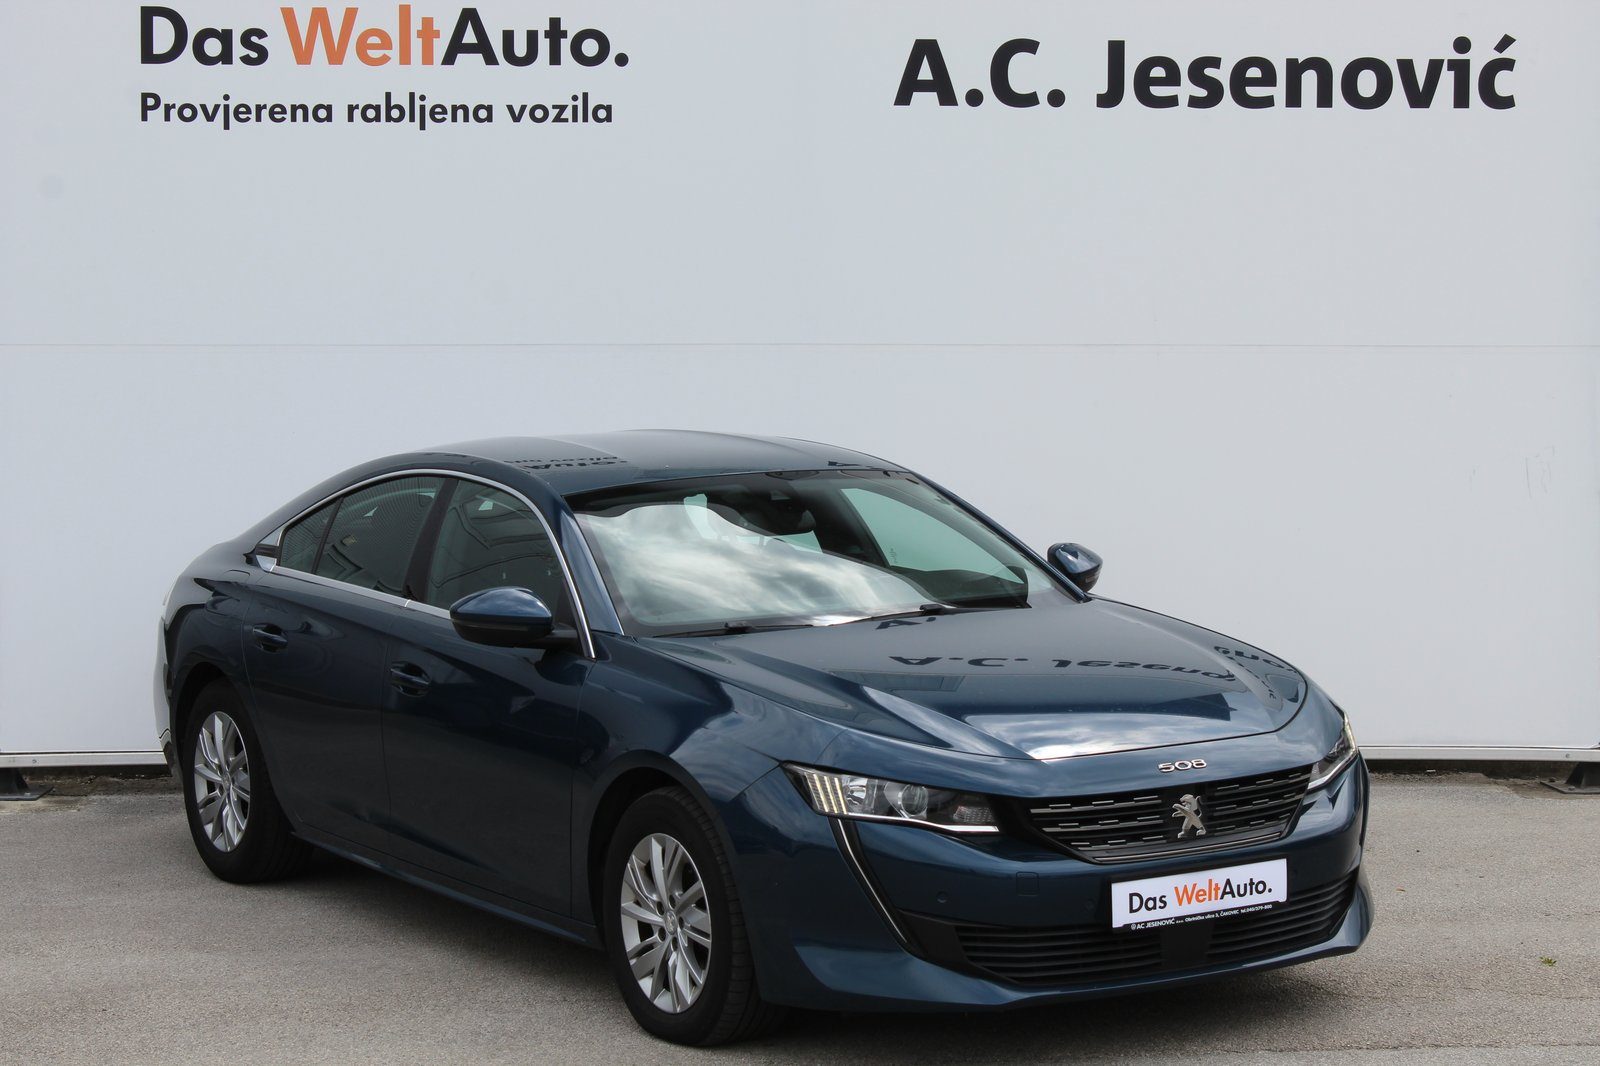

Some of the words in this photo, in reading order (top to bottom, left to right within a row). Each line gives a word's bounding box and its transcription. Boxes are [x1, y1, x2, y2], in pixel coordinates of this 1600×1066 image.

[140, 5, 269, 67] Das
[280, 4, 629, 68] WeltAuto.
[893, 38, 1066, 109] A.C.
[1096, 33, 1517, 110] Jesenović
[140, 92, 333, 131] Provjerena
[347, 91, 493, 131] rabljena
[505, 91, 613, 124] vozila
[1158, 758, 1207, 773] 508
[1128, 892, 1168, 914] Das
[1174, 878, 1273, 907] WeltAuto.
[1145, 917, 1176, 929] JESENOVIĆ
